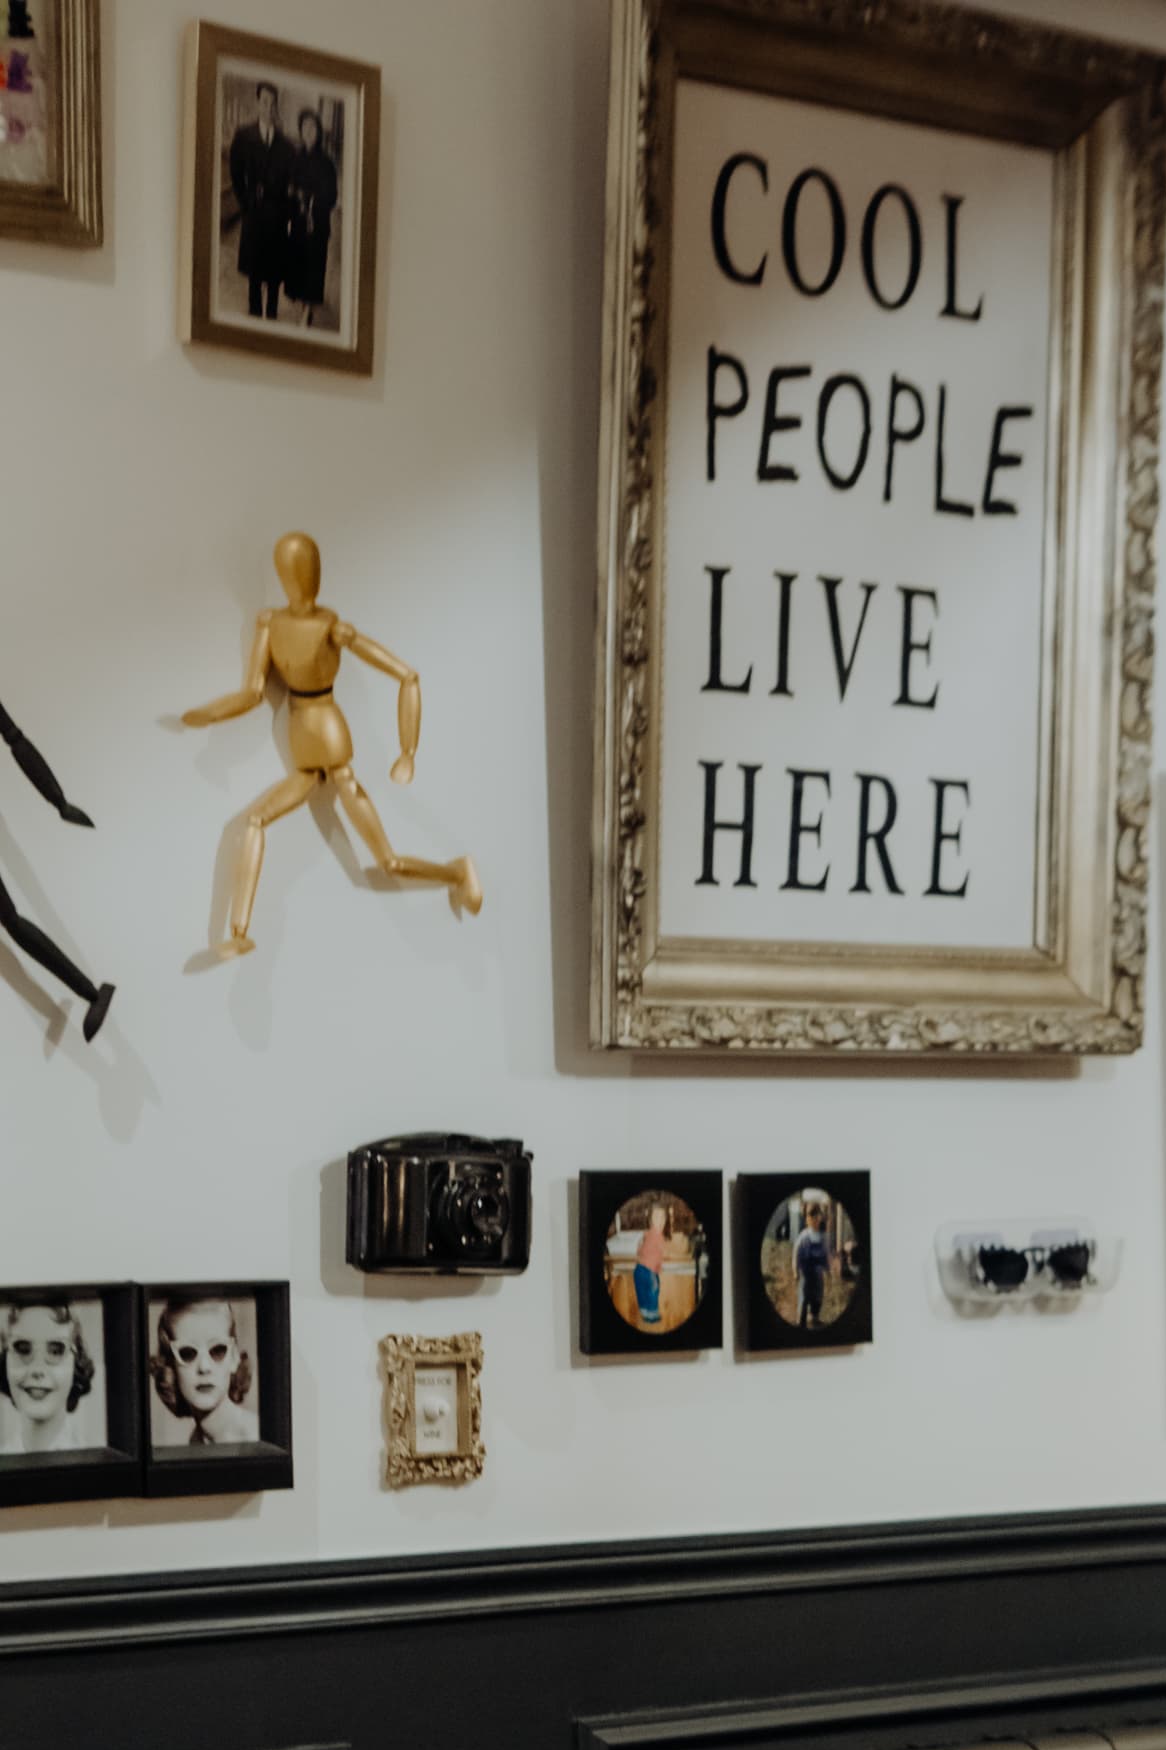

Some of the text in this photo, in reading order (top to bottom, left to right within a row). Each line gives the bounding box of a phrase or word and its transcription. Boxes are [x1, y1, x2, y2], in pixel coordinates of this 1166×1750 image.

[709, 151, 984, 323] COOL
[705, 343, 1035, 519] PEOPLE
[699, 564, 940, 710] LIVE
[693, 759, 970, 899] HERE
